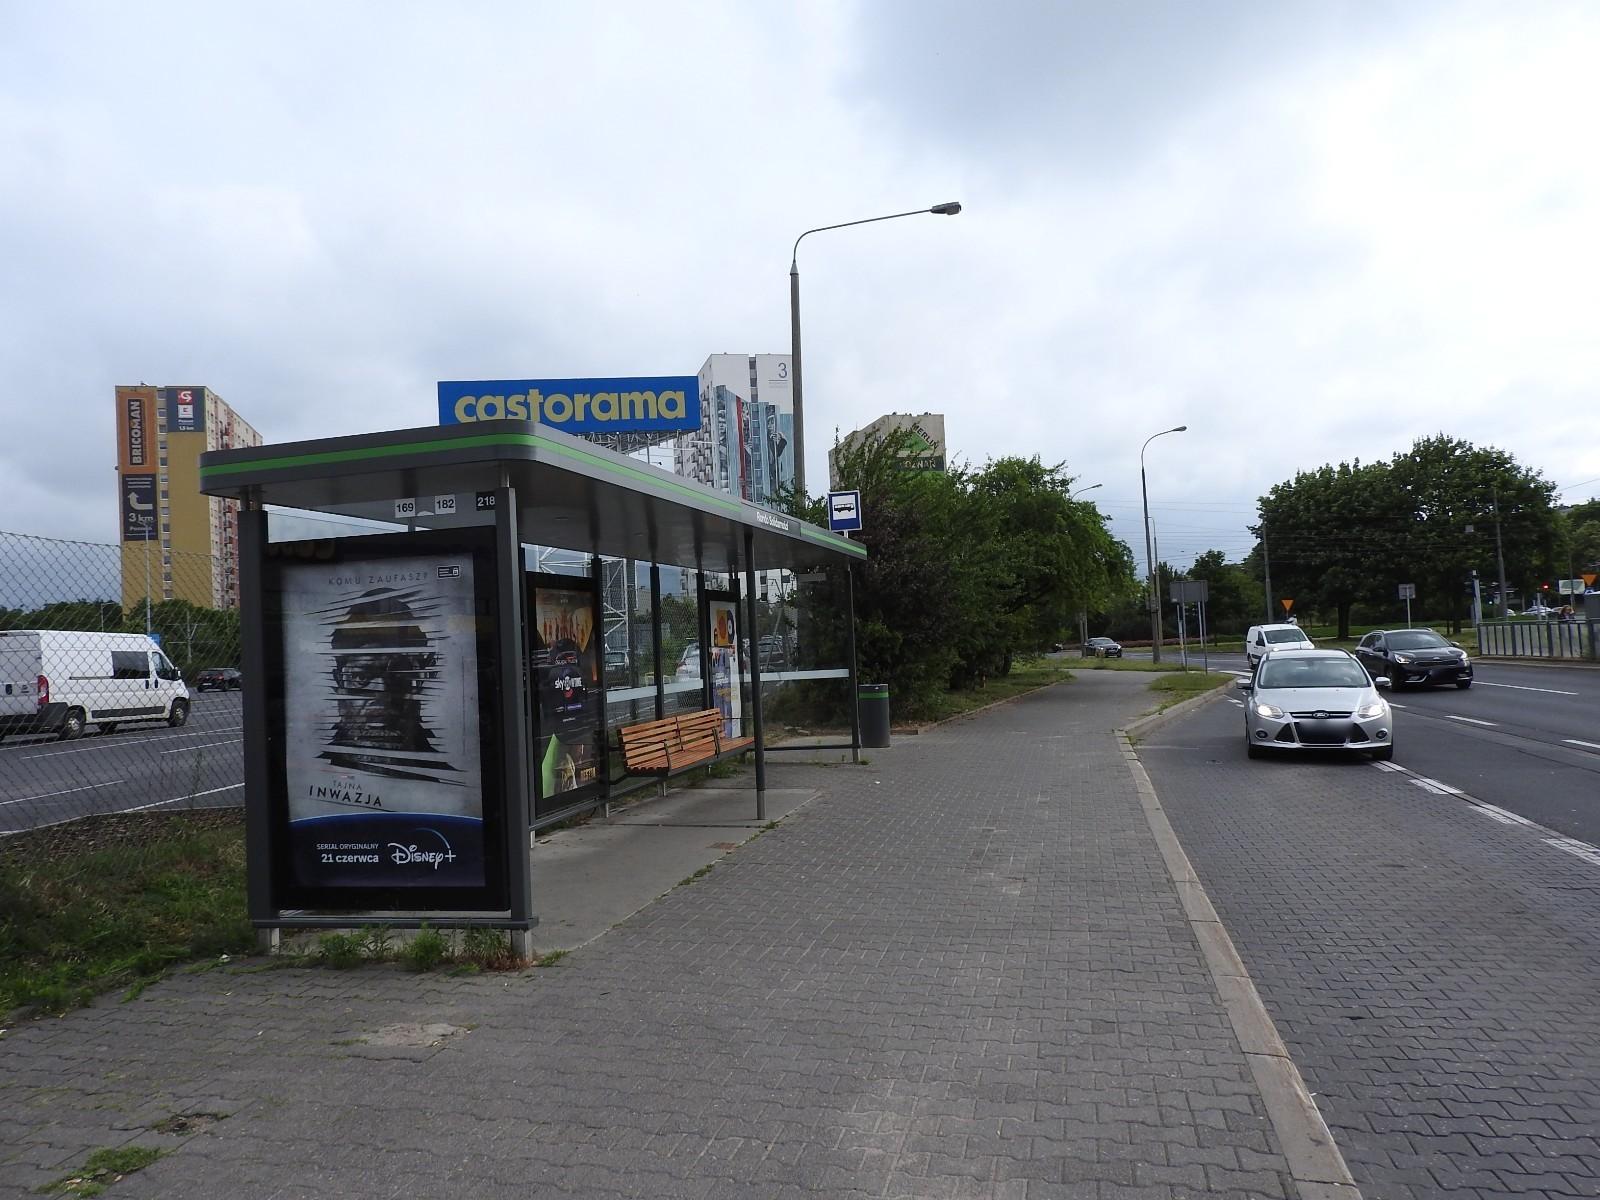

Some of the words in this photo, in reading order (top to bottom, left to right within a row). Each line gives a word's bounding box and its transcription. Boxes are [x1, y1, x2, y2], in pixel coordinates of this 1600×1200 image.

[778, 362, 788, 379] 3
[454, 388, 686, 423] castorama
[130, 401, 143, 464] BRICOMAN
[911, 421, 939, 450] MERLIN
[436, 498, 455, 509] 182
[477, 496, 496, 507] 218
[396, 502, 414, 513] 169
[128, 512, 137, 522] 3
[138, 513, 154, 522] km
[328, 576, 361, 586] KOMU
[309, 785, 382, 807] INWAZJA
[321, 853, 334, 863] 21
[335, 854, 379, 863] czerwca
